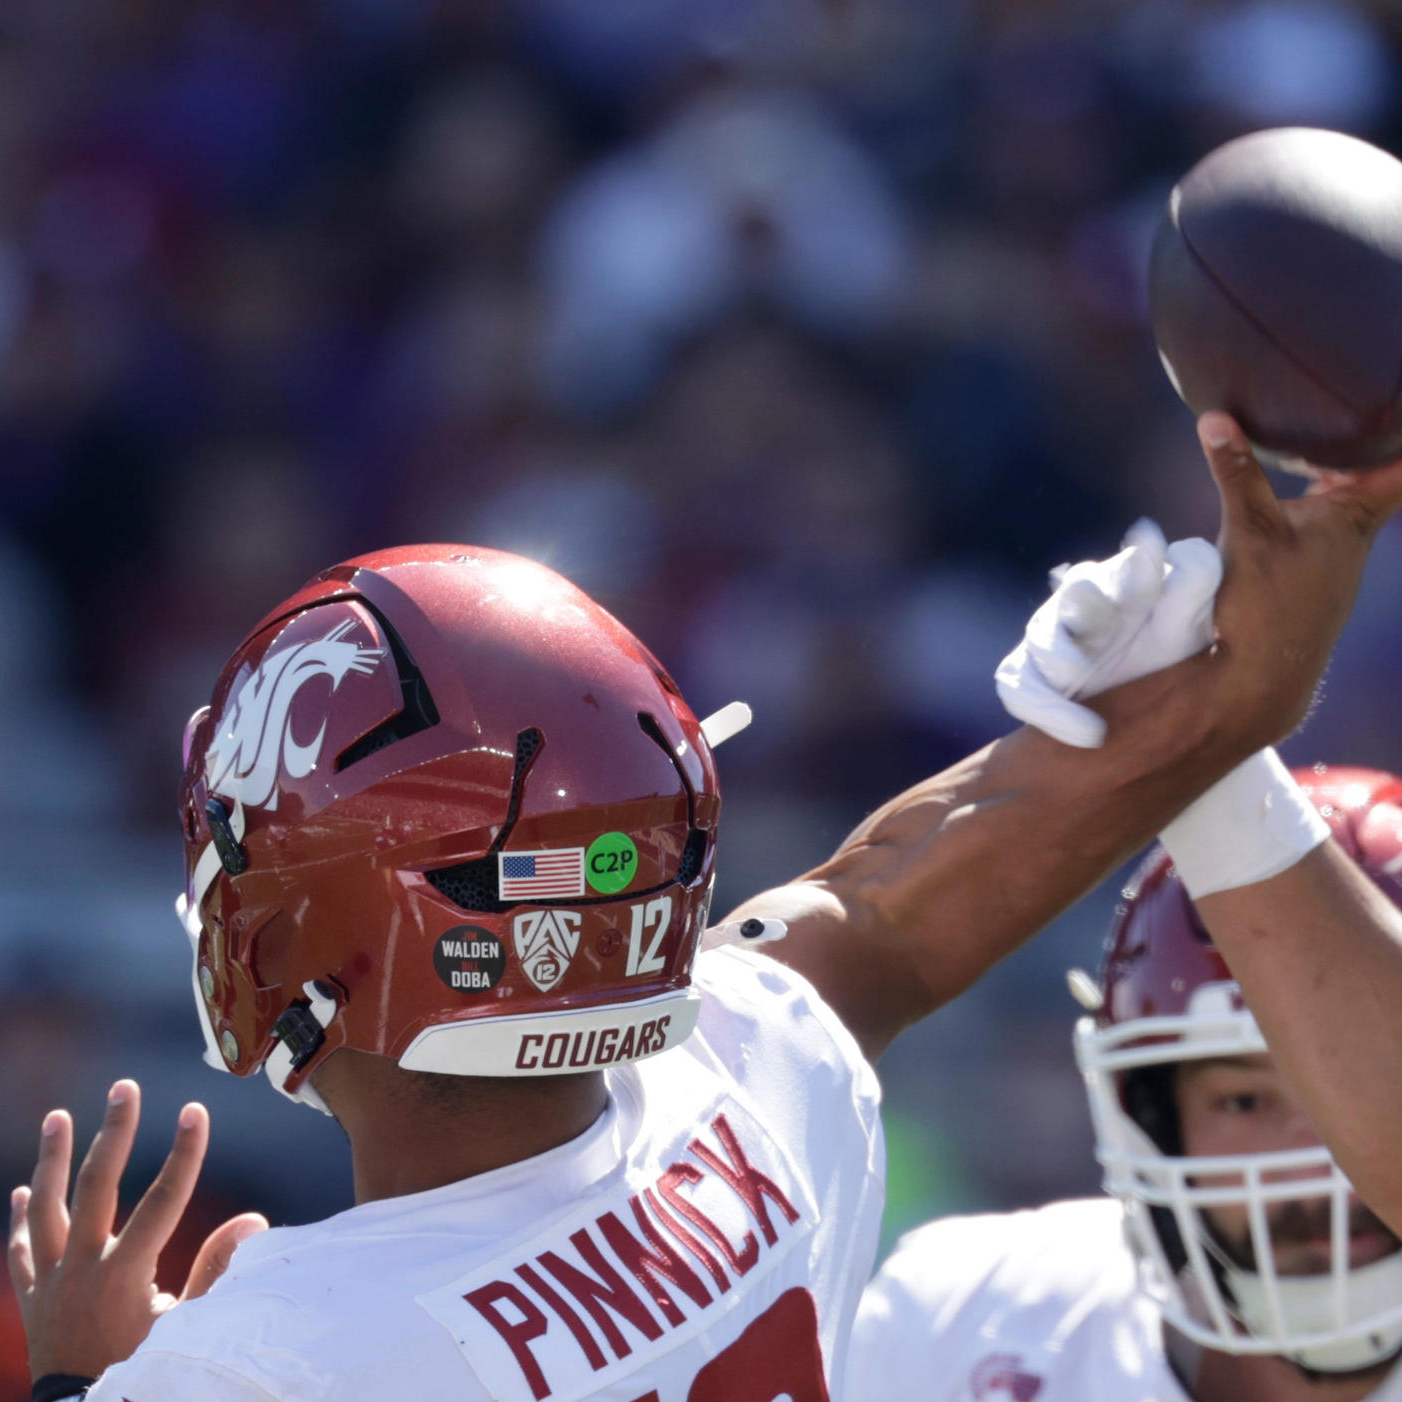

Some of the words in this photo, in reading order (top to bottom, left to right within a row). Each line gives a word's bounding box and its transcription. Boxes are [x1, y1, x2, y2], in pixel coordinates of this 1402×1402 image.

[590, 849, 633, 875] C2P
[441, 940, 499, 959] WALDEN
[513, 909, 582, 961] PAC
[625, 896, 673, 977] 12
[451, 970, 491, 988] DOBA
[535, 963, 555, 981] 12
[515, 1015, 671, 1069] COUGARS
[461, 1112, 801, 1402] PINNICK
